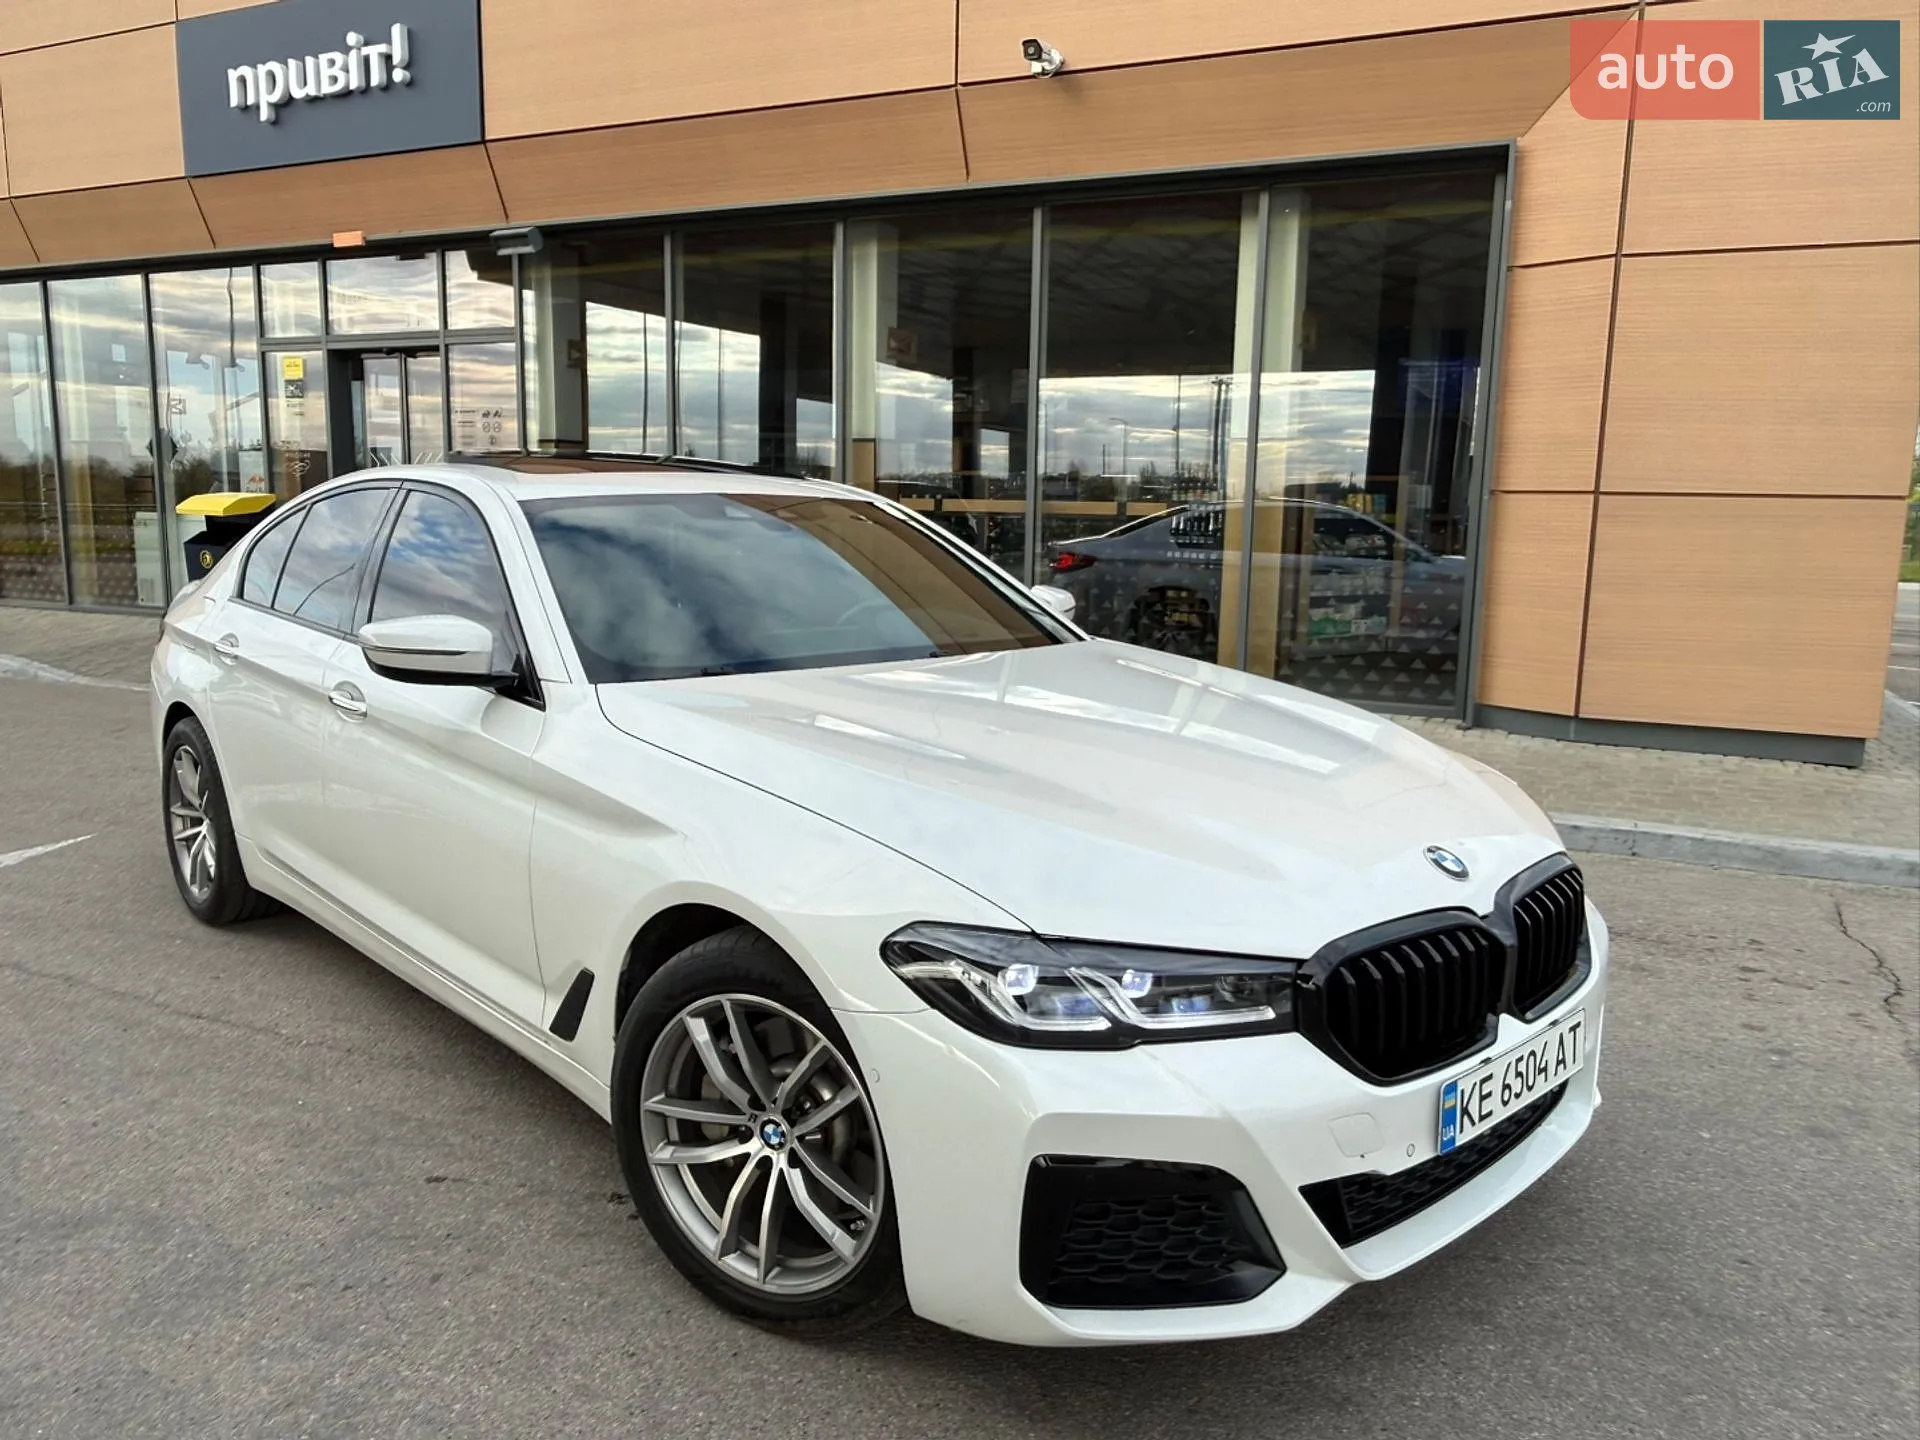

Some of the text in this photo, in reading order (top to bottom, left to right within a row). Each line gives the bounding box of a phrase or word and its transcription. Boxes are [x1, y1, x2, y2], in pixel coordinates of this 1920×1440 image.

[227, 22, 411, 123] привіт!
[1459, 1020, 1582, 1134] KE 6504 AT
[1442, 1123, 1455, 1141] UA
